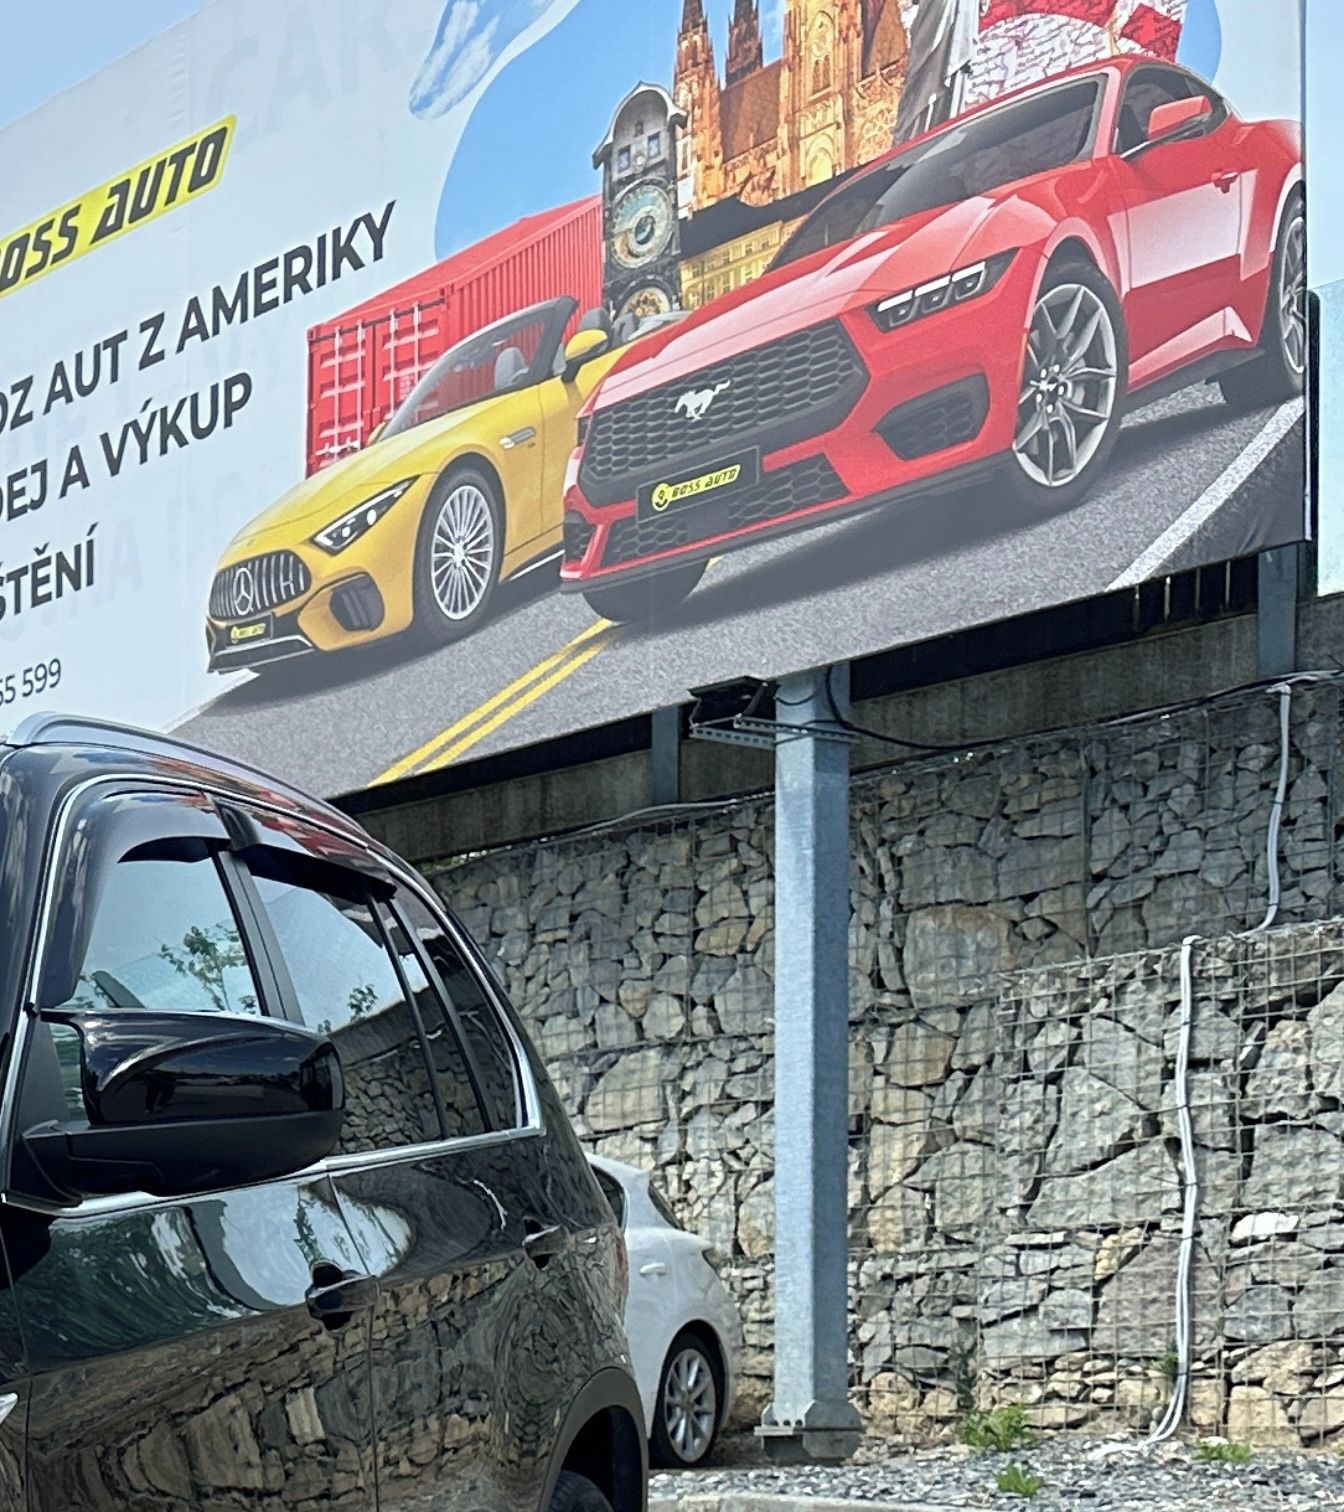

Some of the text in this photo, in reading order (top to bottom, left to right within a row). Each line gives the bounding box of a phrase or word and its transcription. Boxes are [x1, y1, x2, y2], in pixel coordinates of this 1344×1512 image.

[89, 125, 229, 246] AUTO
[43, 329, 128, 415] AUT
[138, 312, 166, 371] Z
[176, 200, 397, 354] AMERIKY
[58, 446, 91, 500] A
[100, 370, 253, 477] VÝKUP
[22, 658, 62, 699] 599
